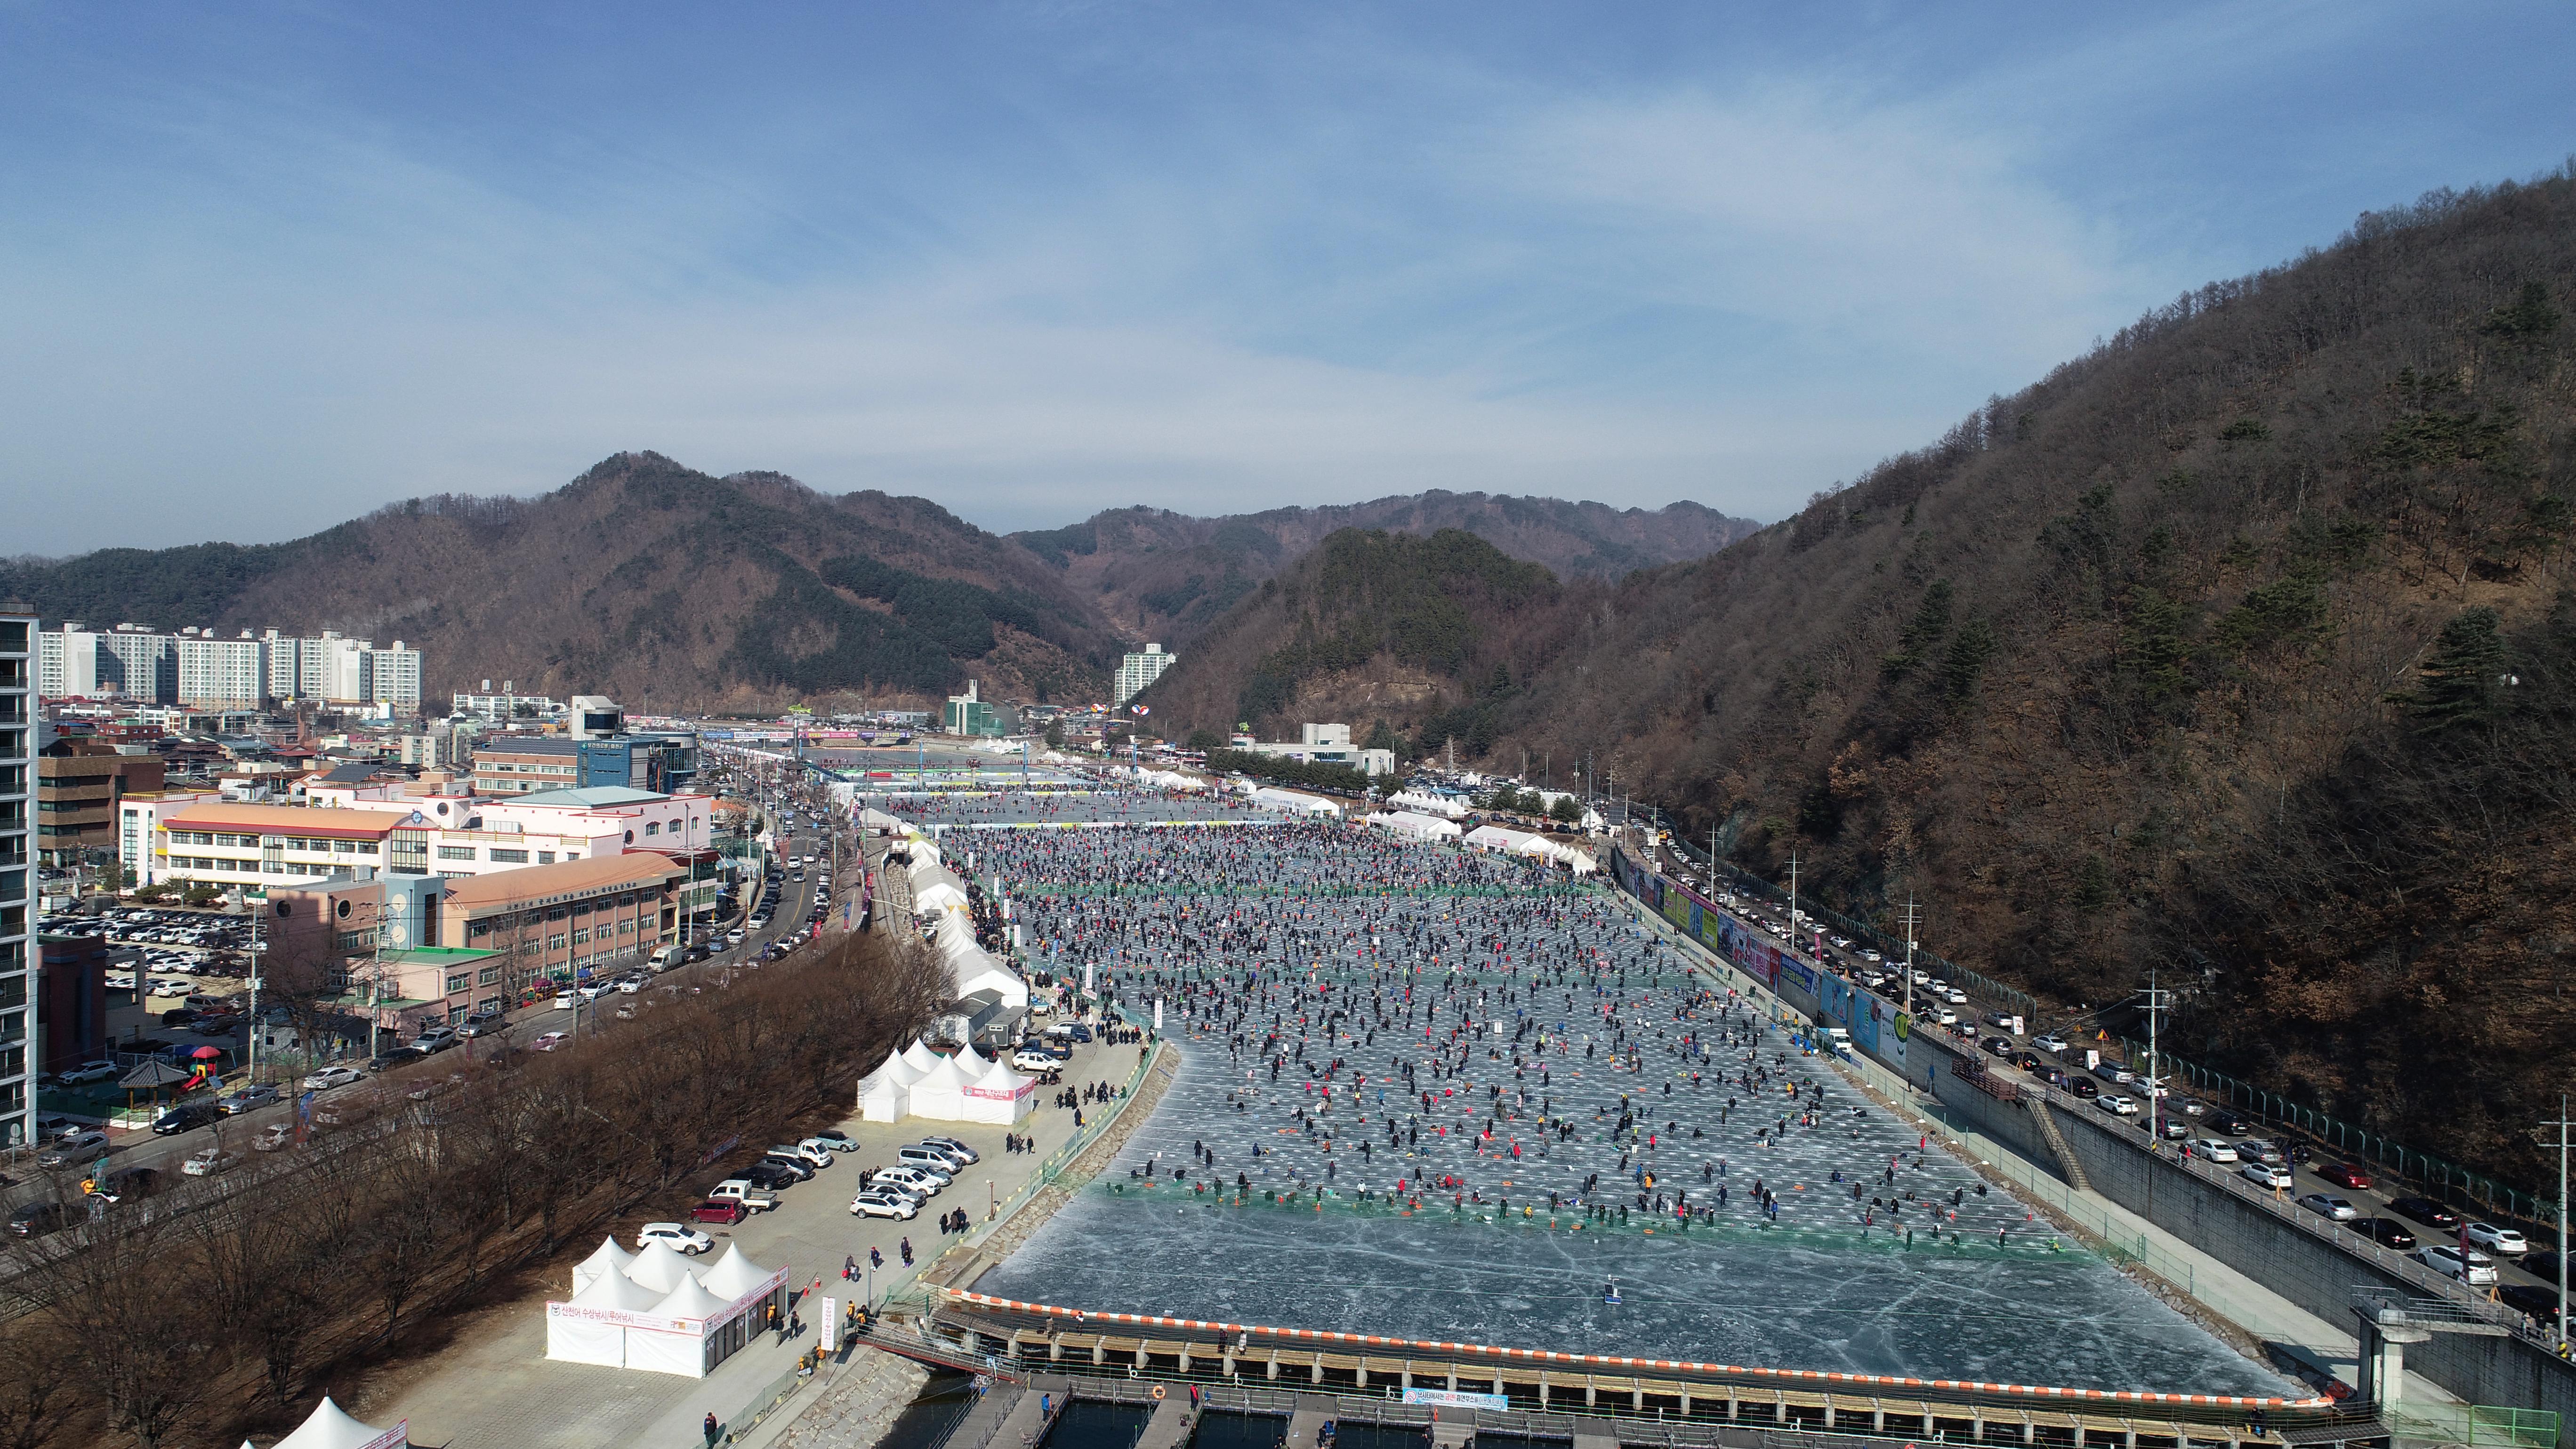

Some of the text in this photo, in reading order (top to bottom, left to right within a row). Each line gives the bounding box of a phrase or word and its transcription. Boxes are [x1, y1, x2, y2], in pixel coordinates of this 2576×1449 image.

[984, 1089, 1009, 1097] 재난구조대
[562, 1306, 580, 1317] 산천어
[582, 1308, 634, 1324] 수상낚시/루어낚시
[1417, 1391, 1444, 1401] 낚시터에서는
[1457, 1394, 1479, 1403] 흡연부스를
